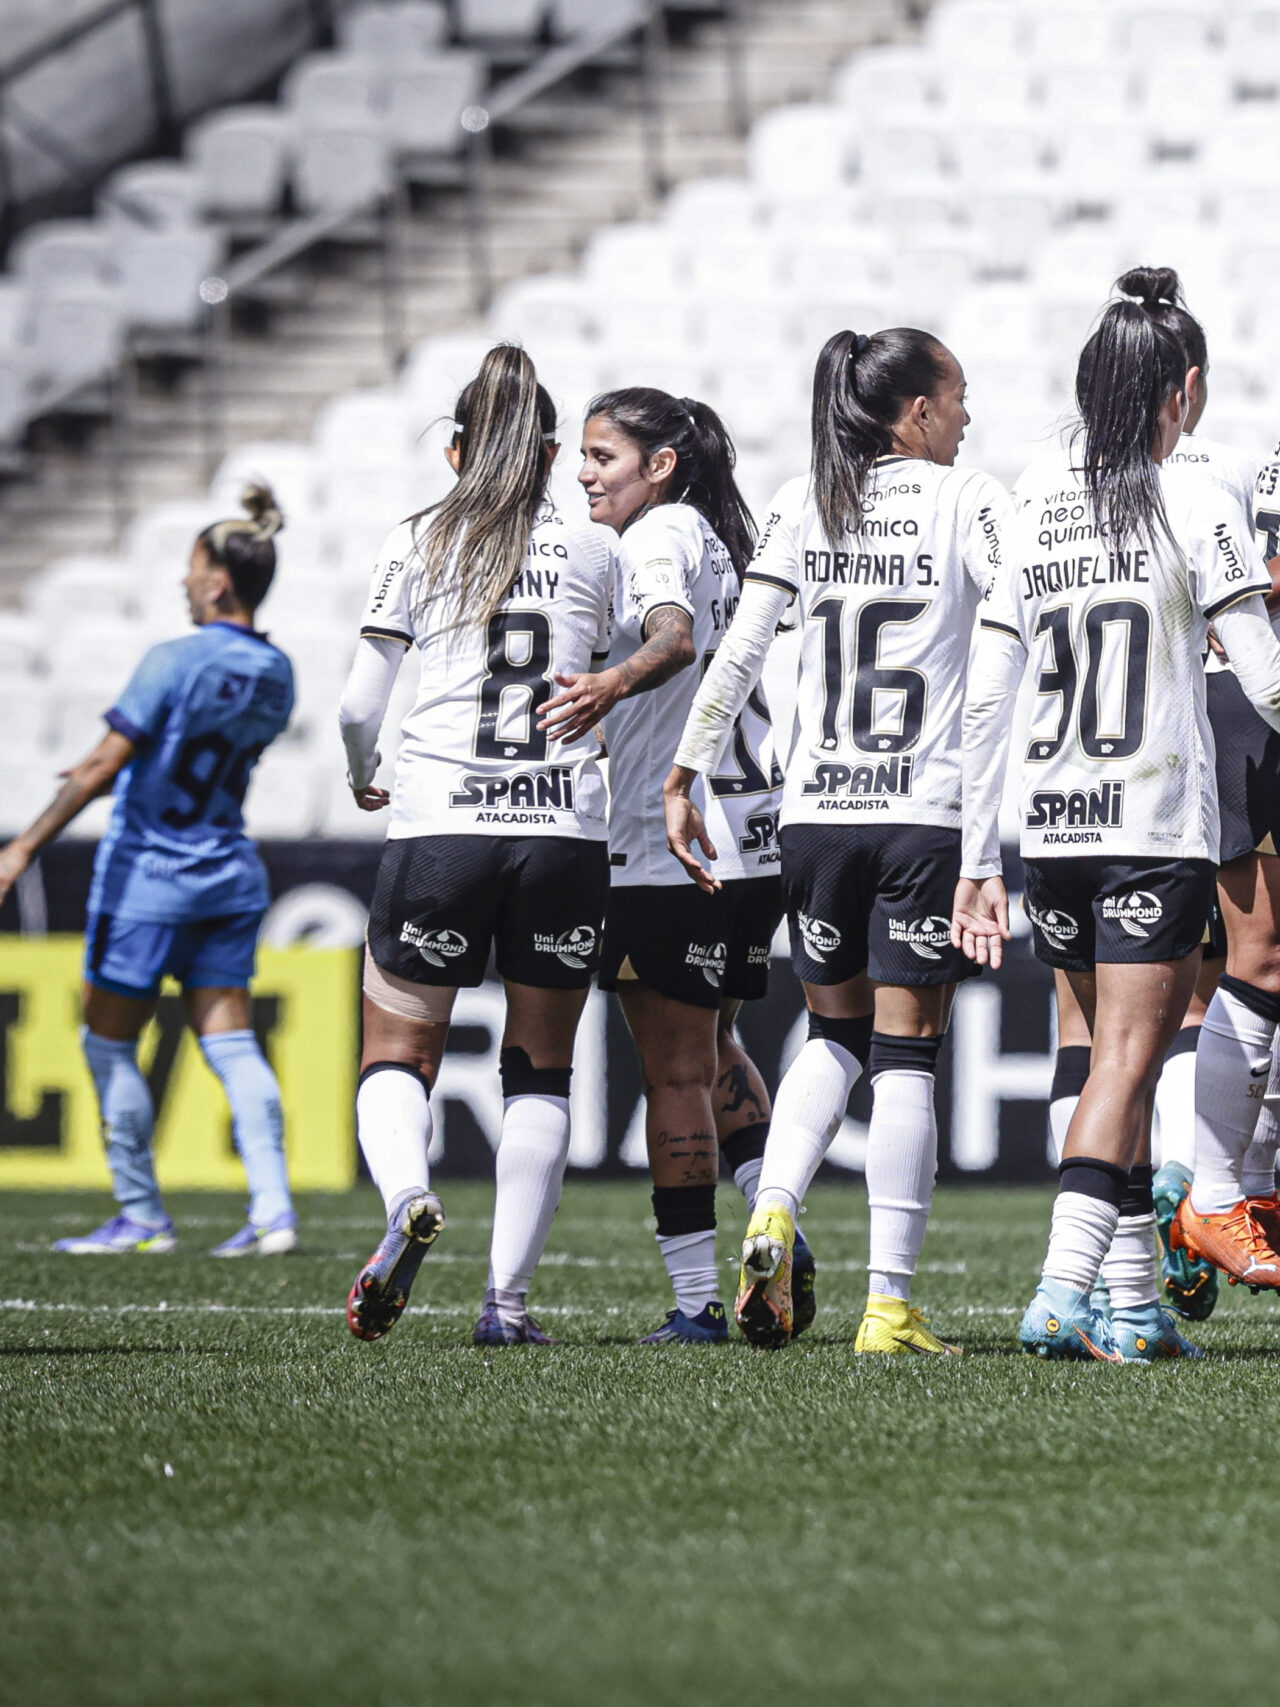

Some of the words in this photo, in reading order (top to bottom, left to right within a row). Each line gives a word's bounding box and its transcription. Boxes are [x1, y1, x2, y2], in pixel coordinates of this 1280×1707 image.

[1040, 505, 1085, 525] neo
[845, 514, 919, 537] uímica
[1216, 535, 1245, 584] bmg
[916, 554, 940, 587] S.
[374, 560, 404, 601] bmg
[806, 595, 933, 755] 16
[1024, 598, 1153, 763] 30
[472, 609, 554, 762] 8
[817, 800, 890, 811] ATACADISTA
[476, 813, 558, 825] ATACADISTA
[1042, 831, 1103, 844] ATACADISTA
[1103, 907, 1162, 918] DRUMMOND
[402, 921, 423, 937] Uni
[889, 918, 906, 931] Uni
[399, 930, 467, 954] DRUMMOND
[533, 932, 555, 945] Uni
[534, 936, 596, 954] DRUMMOND
[688, 942, 707, 957] Uni
[748, 945, 768, 955] Uni
[685, 954, 726, 970] DRUMMO
